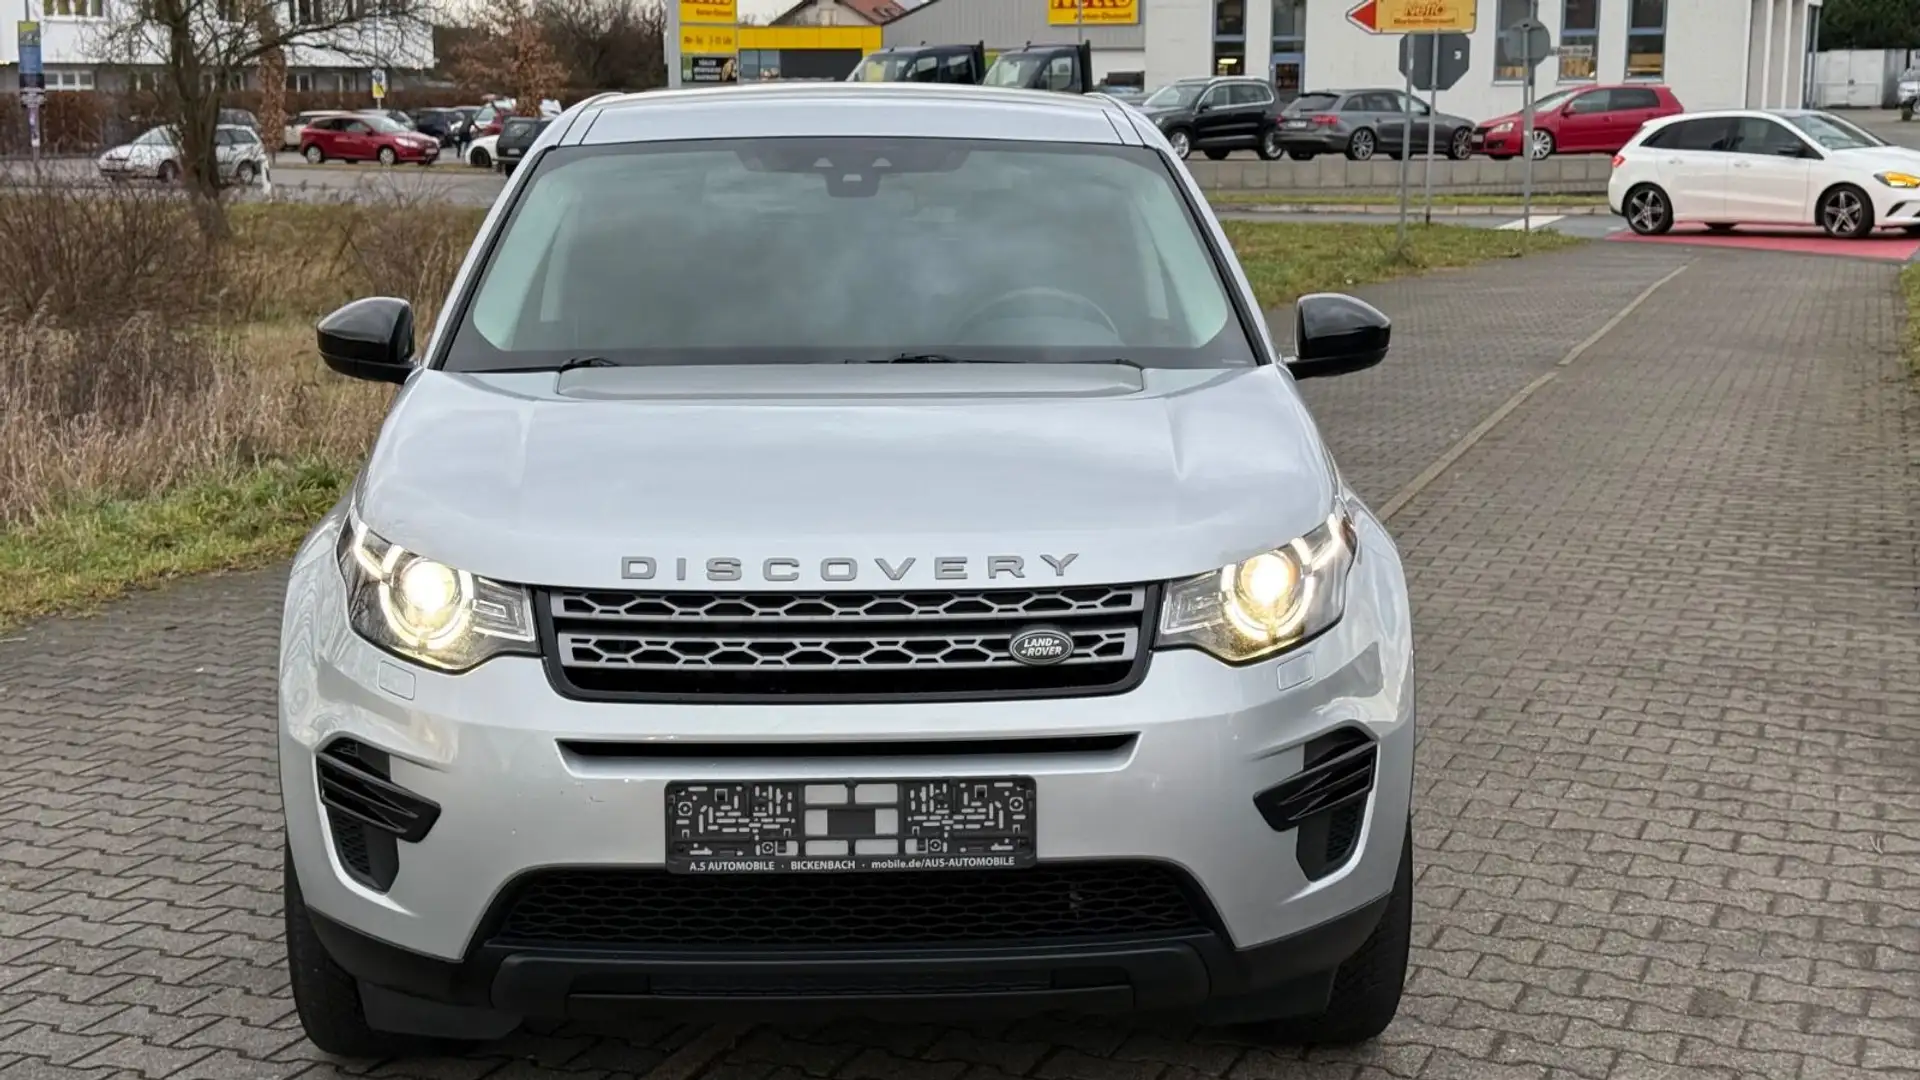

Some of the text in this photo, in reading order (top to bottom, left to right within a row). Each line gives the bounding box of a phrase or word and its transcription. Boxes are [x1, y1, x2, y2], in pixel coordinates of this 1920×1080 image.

[621, 553, 1079, 581] DISCOVERY
[1024, 638, 1053, 647] LAND
[1027, 646, 1062, 656] ROVER
[708, 862, 775, 870] AUTOMOBILE
[791, 861, 856, 870] BICKENBACH
[871, 857, 1016, 869] mobile.de/AUS-AUTOMOBILE
